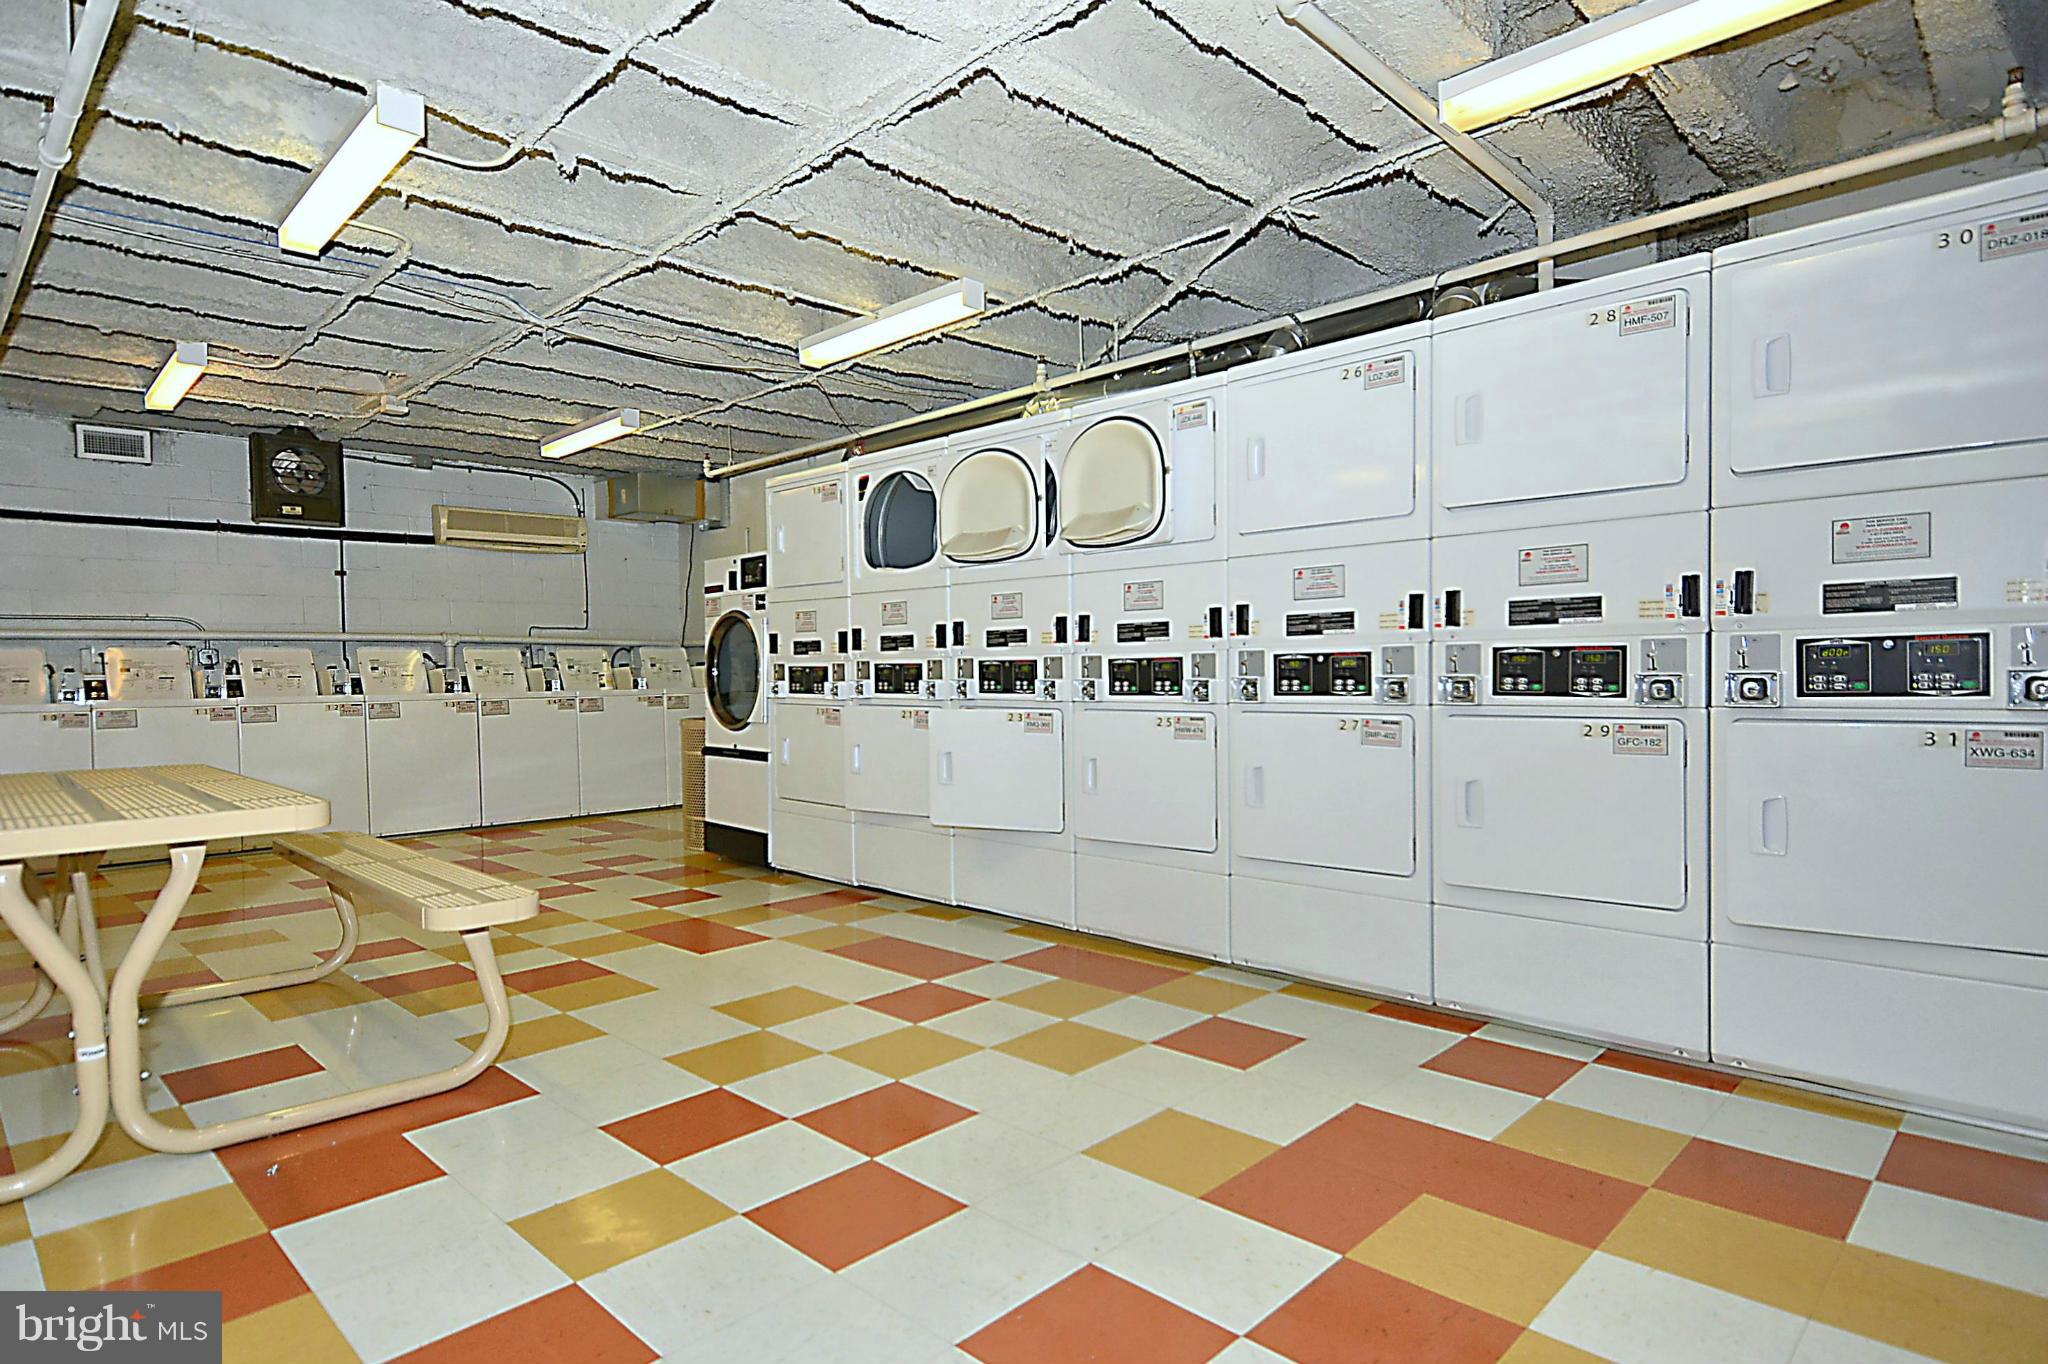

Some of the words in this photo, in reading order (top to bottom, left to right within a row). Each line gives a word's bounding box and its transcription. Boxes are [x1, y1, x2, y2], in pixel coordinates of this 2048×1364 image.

[1624, 311, 1669, 327] HMF-507
[1617, 737, 1662, 747] GFC-182
[1970, 746, 2035, 758] XWG-634
